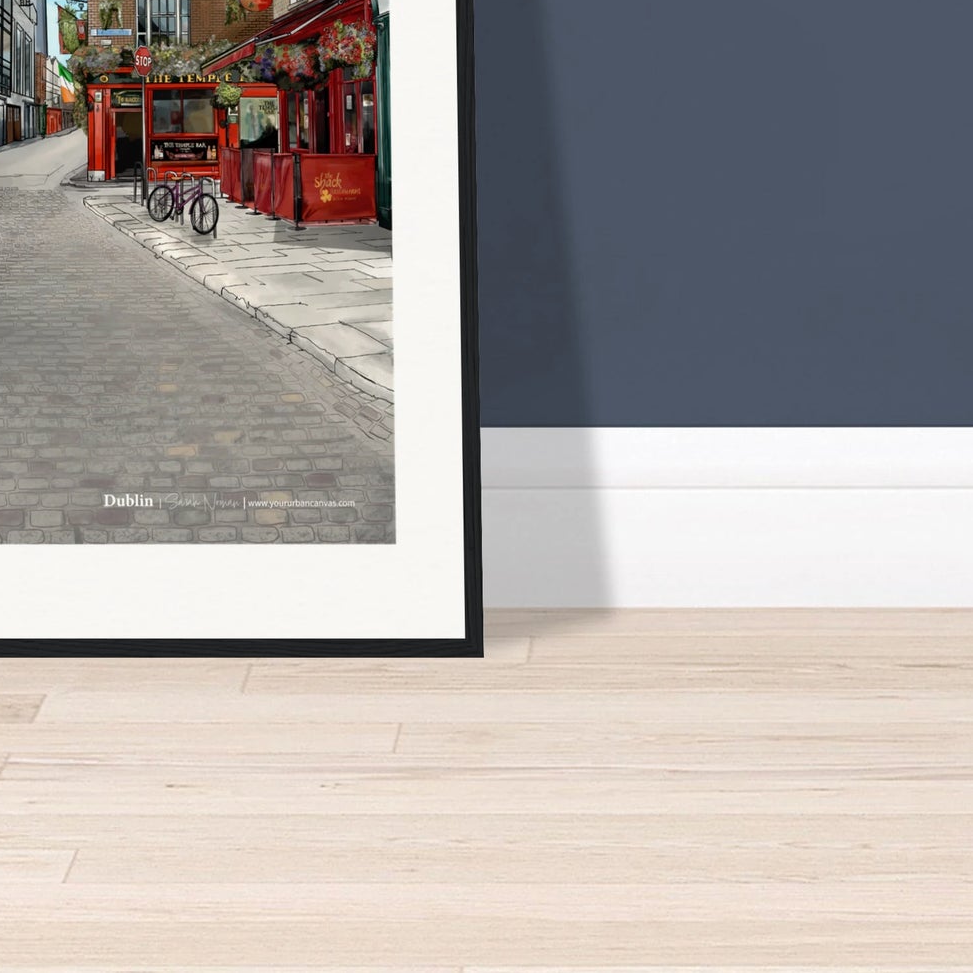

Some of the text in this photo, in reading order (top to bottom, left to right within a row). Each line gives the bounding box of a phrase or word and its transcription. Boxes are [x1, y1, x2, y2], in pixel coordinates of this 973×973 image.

[135, 55, 152, 67] STOP
[103, 493, 154, 508] Dublin
[248, 498, 356, 509] www.yoururbancanvas.com
